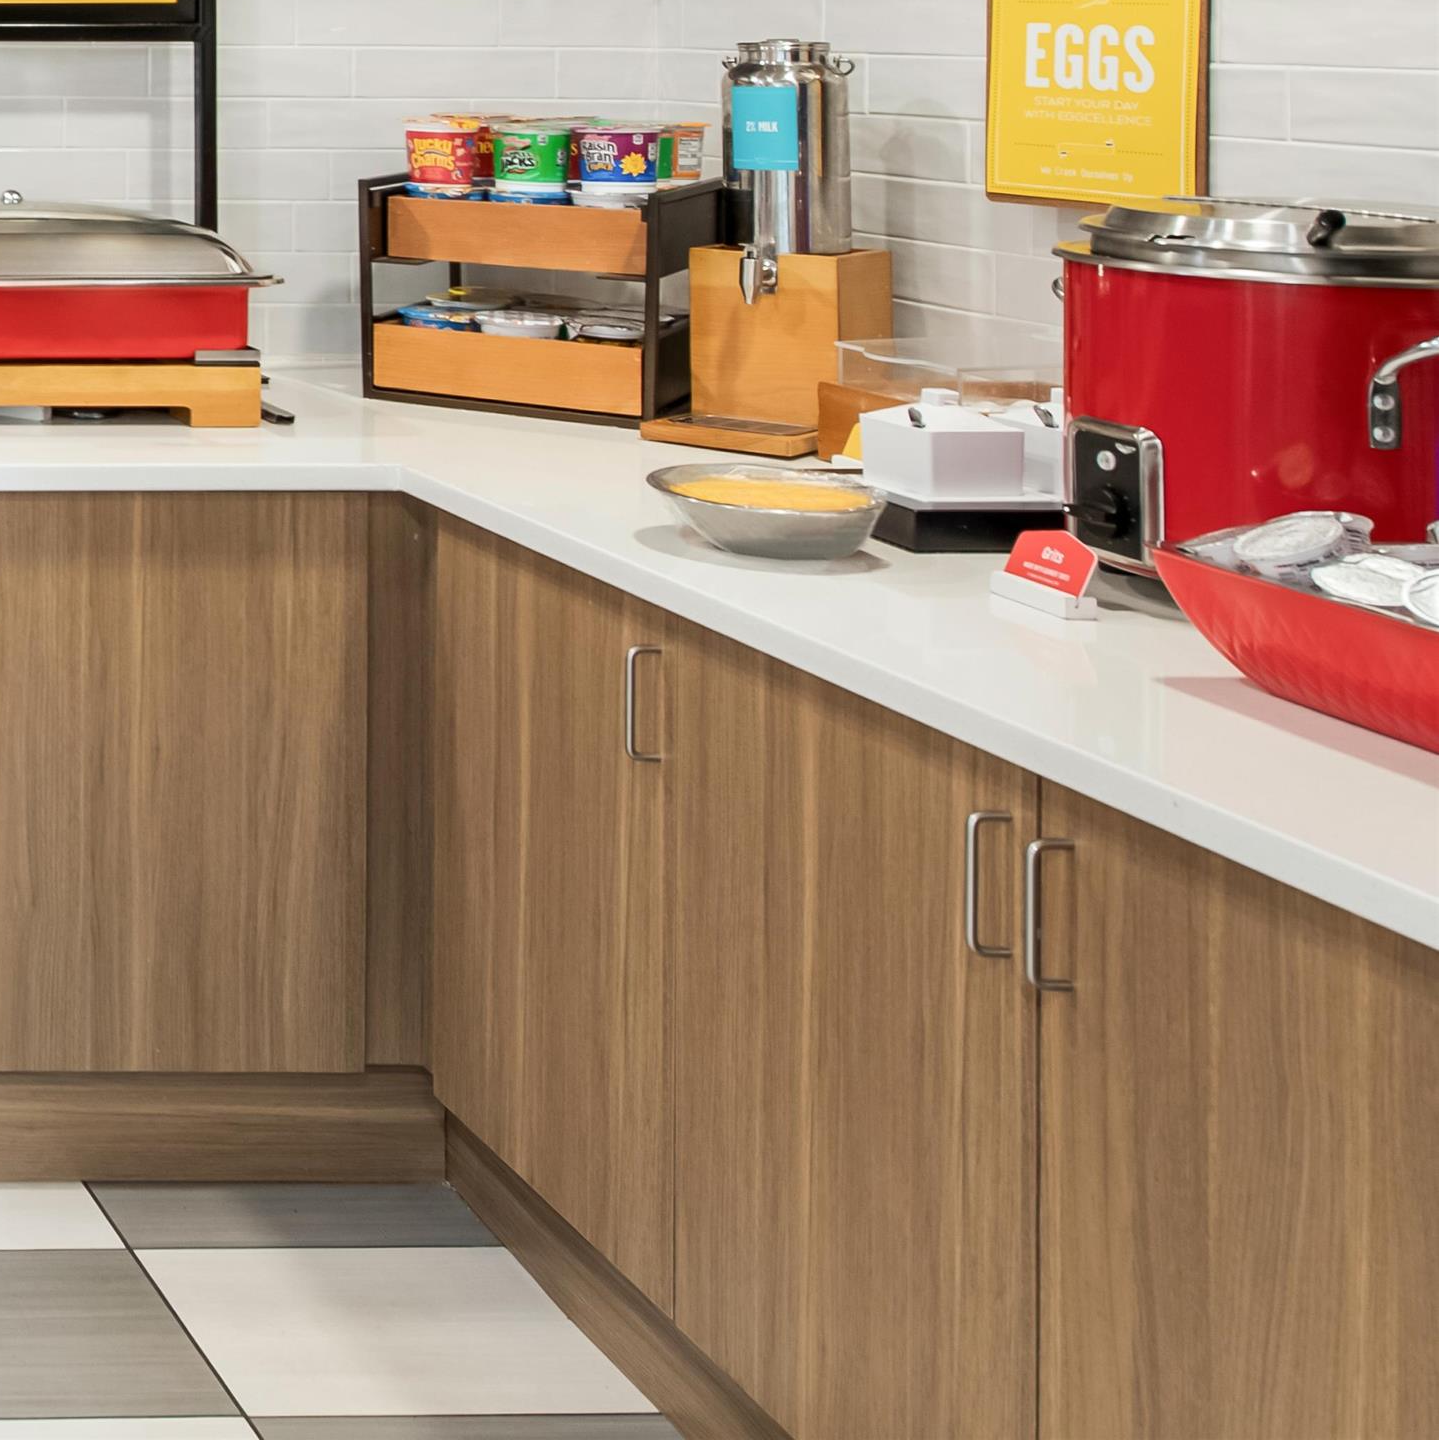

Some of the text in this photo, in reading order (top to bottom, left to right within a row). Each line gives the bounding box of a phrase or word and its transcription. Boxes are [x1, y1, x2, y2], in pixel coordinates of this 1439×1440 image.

[1025, 22, 1155, 94] EGGS
[1033, 95, 1139, 111] START YOUR DAY
[1025, 109, 1055, 120] WITH
[758, 121, 779, 133] MILK
